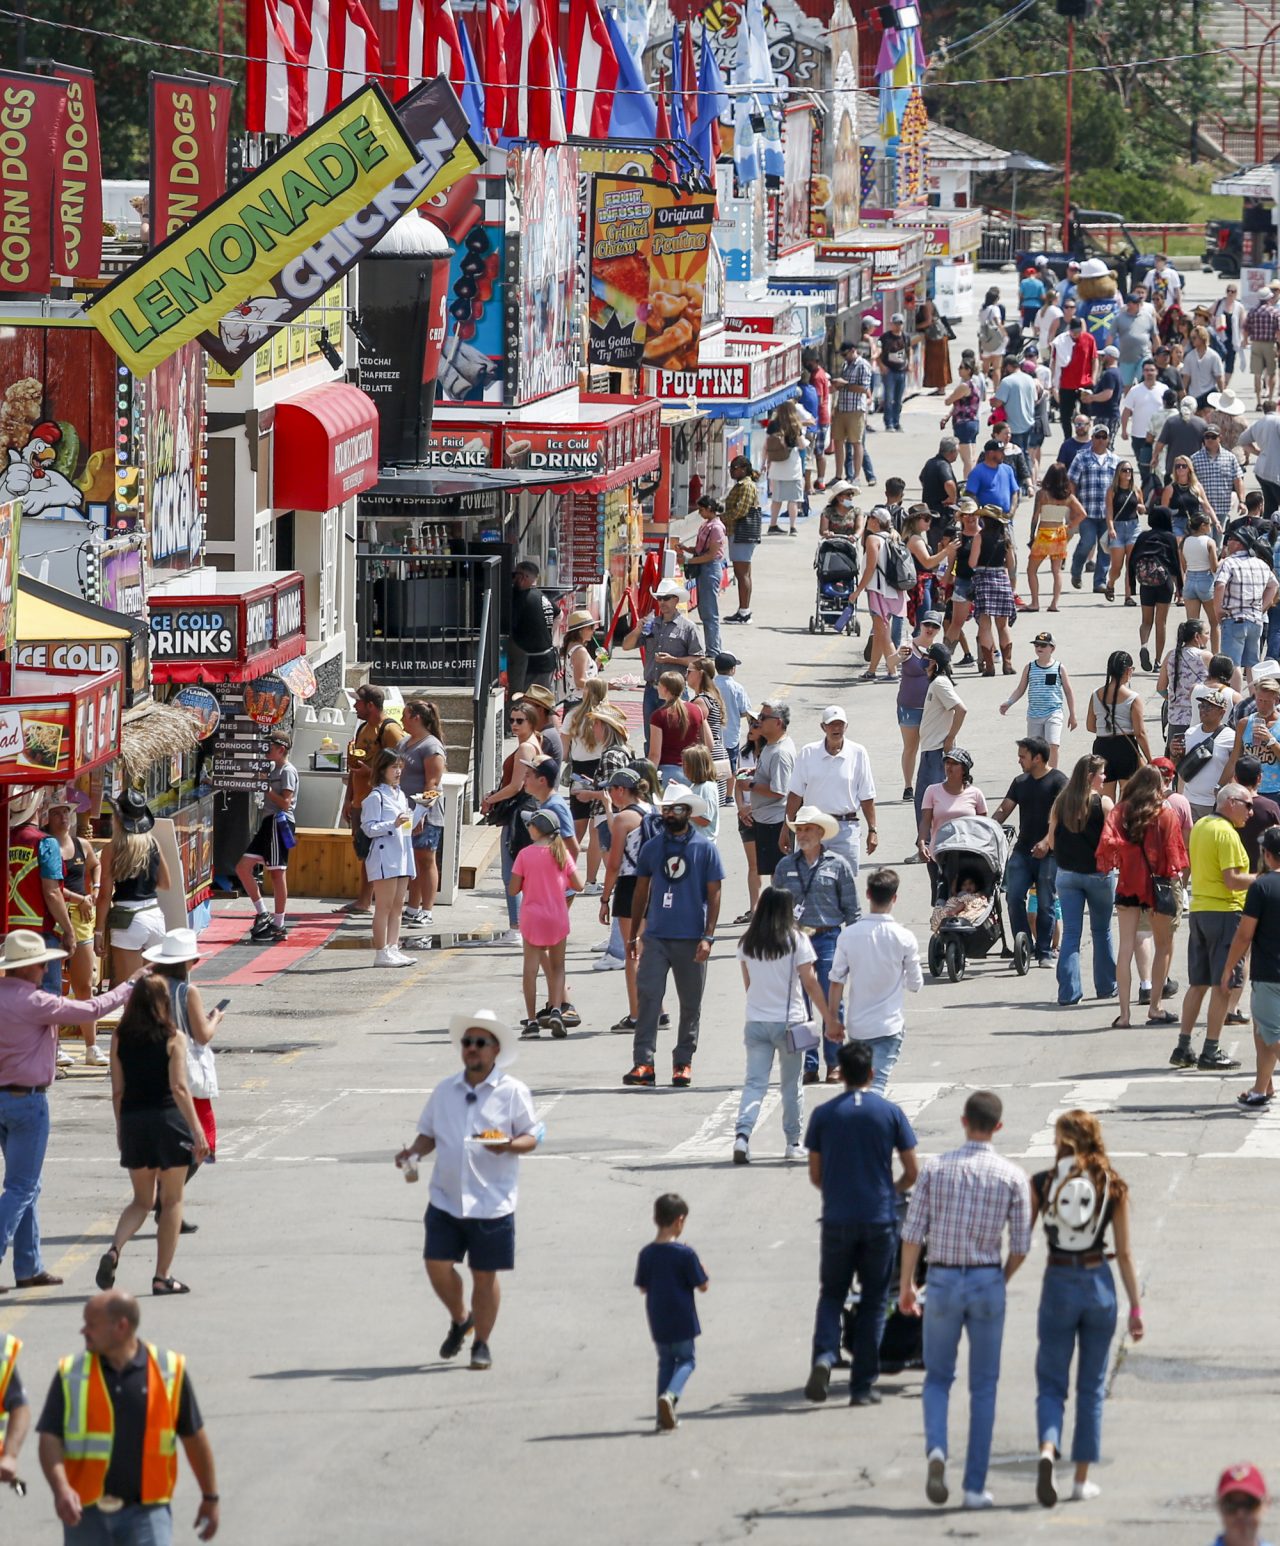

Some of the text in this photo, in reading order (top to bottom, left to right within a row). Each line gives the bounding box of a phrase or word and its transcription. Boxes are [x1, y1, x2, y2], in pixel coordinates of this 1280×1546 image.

[62, 82, 88, 172] DOGS
[166, 91, 200, 236] RN DOGS
[0, 87, 36, 284] CORN DOGS
[605, 190, 642, 207] FRUIT
[281, 118, 458, 300] CHICKEN
[598, 204, 652, 223] INFUSED
[658, 206, 705, 224] Original
[110, 114, 389, 354] LEMONADE
[607, 221, 650, 244] Grilled
[597, 241, 636, 259] Cheese
[653, 233, 708, 255] Poutine
[591, 335, 632, 350] You Gotta
[597, 346, 636, 362] Try This!
[360, 370, 400, 380] CHA FREEZE
[661, 368, 744, 395] POUTINE
[372, 384, 393, 393] LATTE
[430, 451, 486, 466] ECAKE
[530, 451, 598, 468] DRINKS
[152, 614, 224, 631] CE COLD
[53, 645, 119, 670] COLD
[391, 660, 413, 670] FAIR
[415, 660, 443, 670] TRADE
[256, 714, 273, 723] NEW
[257, 742, 269, 752] $6
[214, 780, 268, 791] LEMONADE $6
